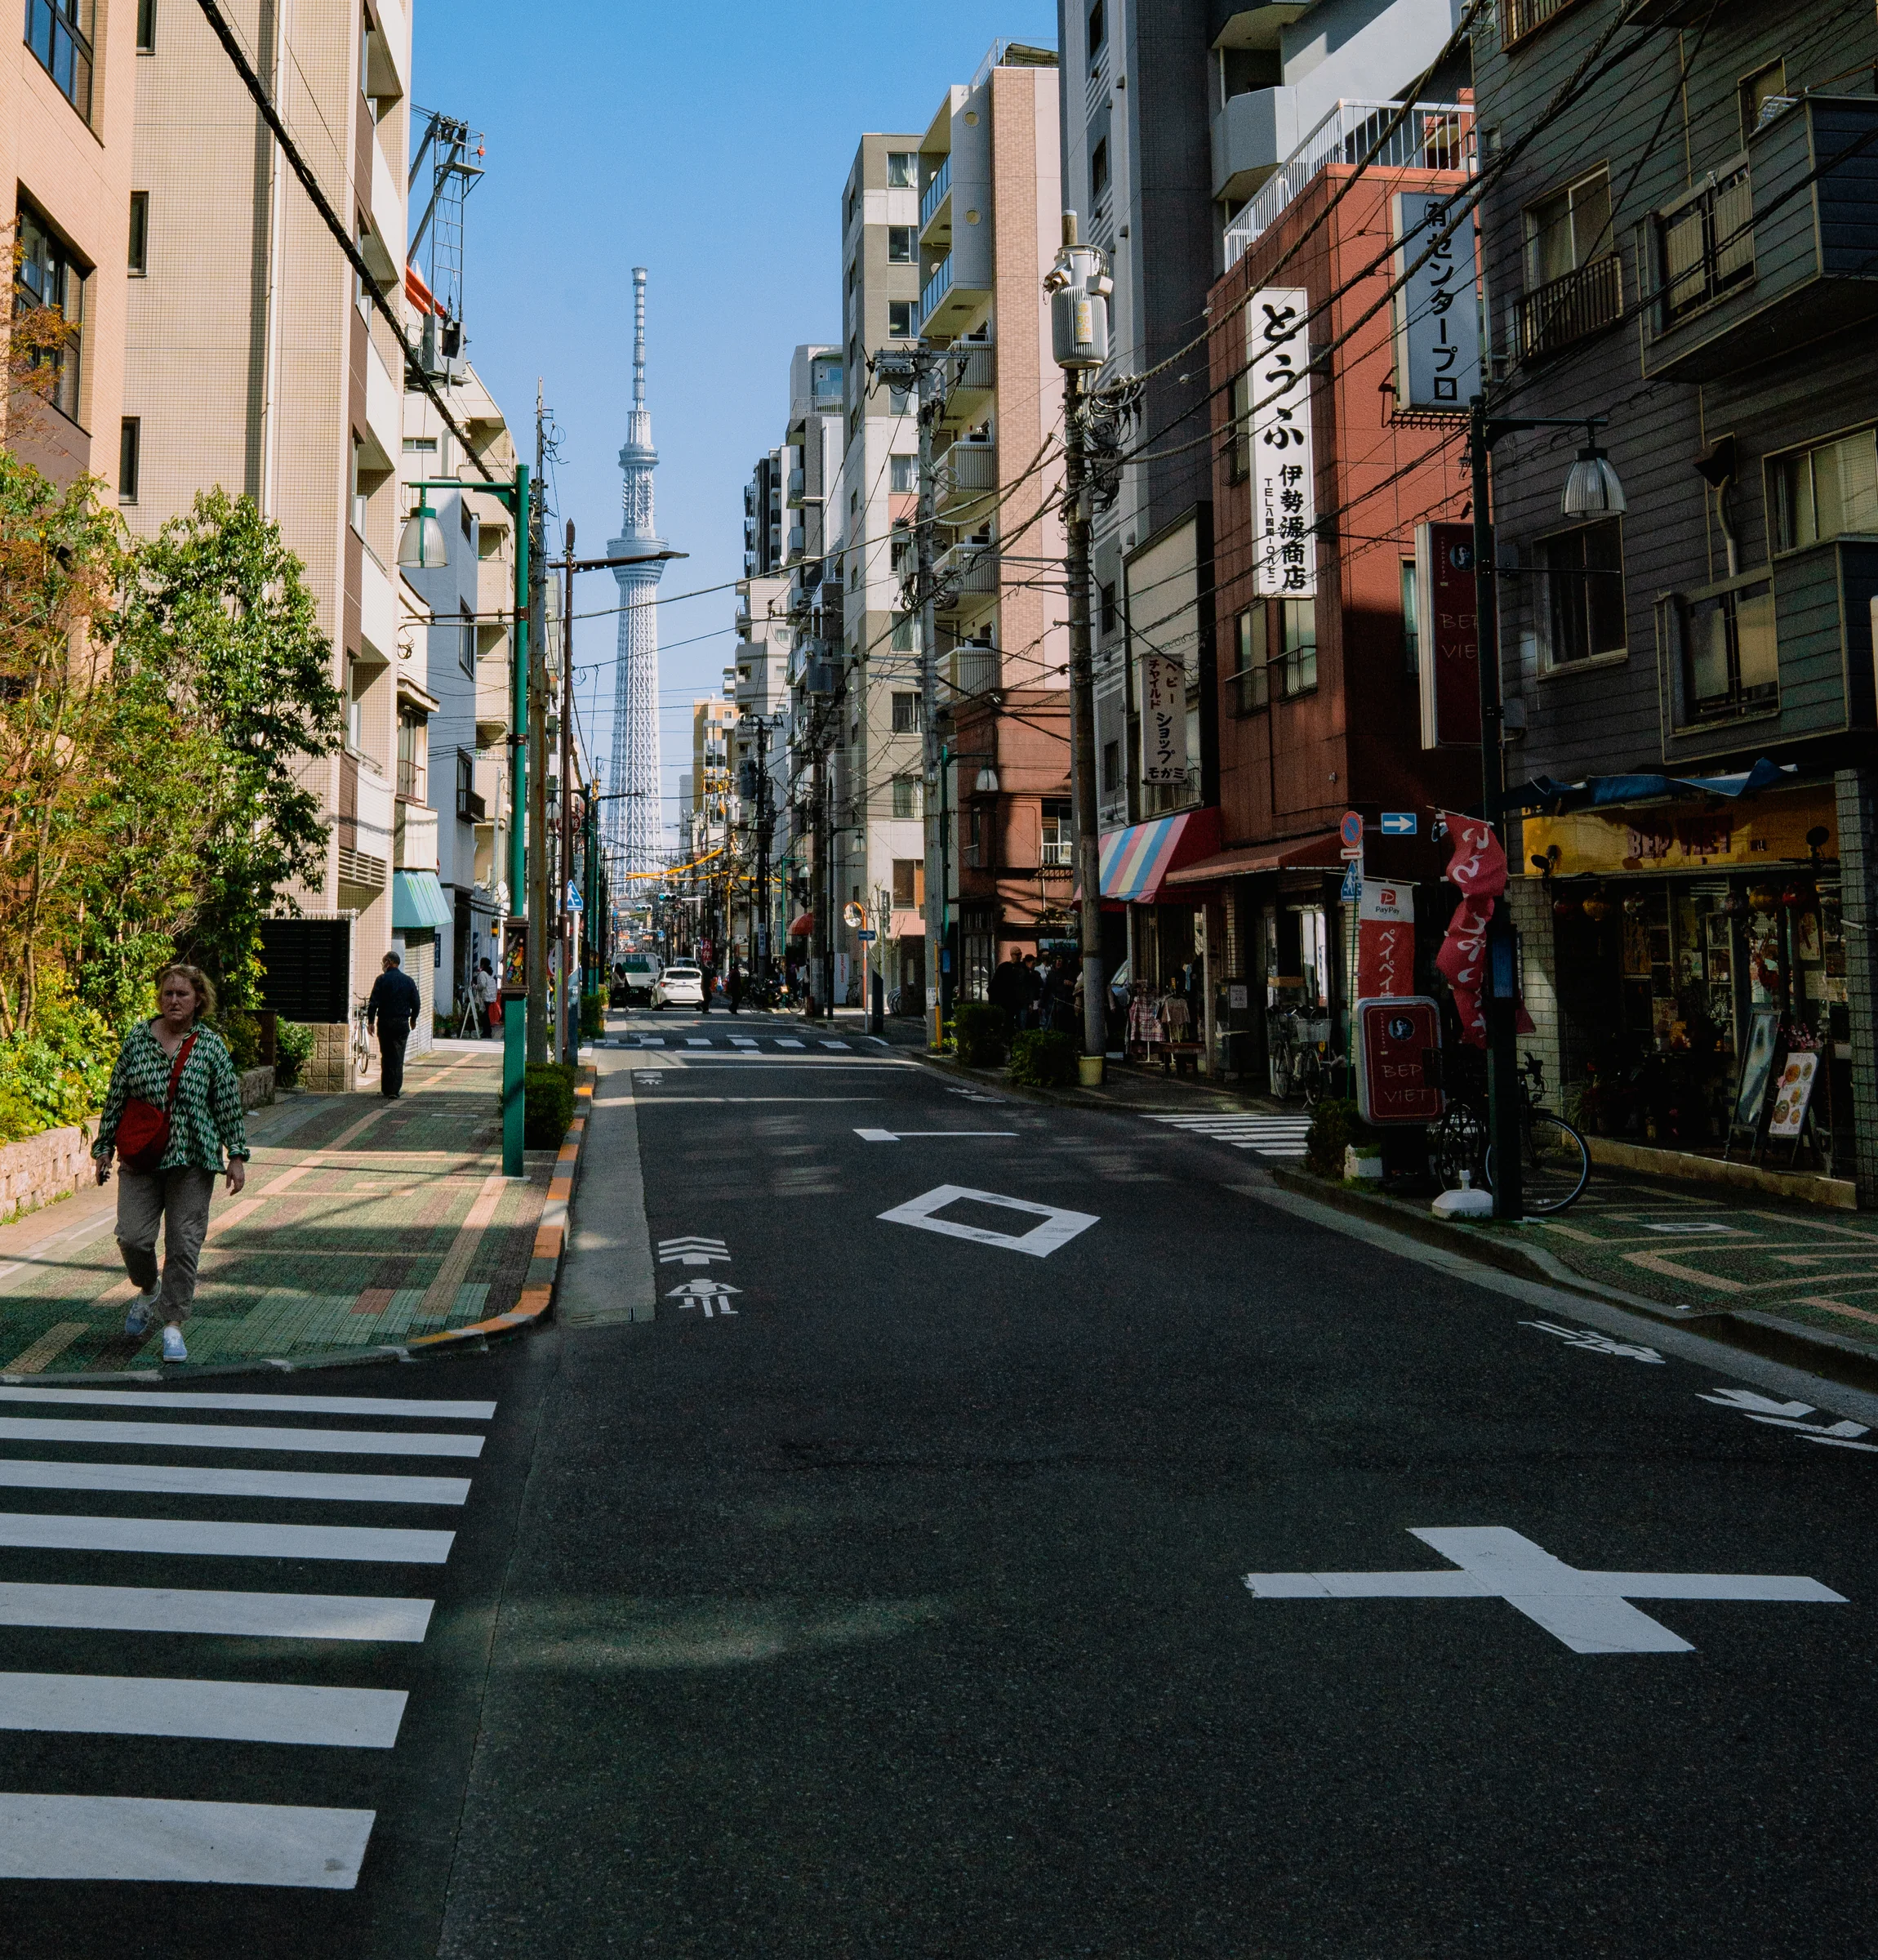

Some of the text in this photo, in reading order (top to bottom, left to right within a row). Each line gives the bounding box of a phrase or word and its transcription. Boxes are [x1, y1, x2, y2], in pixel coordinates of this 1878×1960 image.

[1262, 303, 1304, 449] とうふ
[1278, 463, 1306, 590] 伊勢源商店
[1441, 644, 1479, 658] VIE
[1148, 658, 1162, 710] チャイルド
[1156, 712, 1176, 764] ショップ
[1376, 906, 1400, 914] PayPay
[1384, 1089, 1430, 1102] VIET
